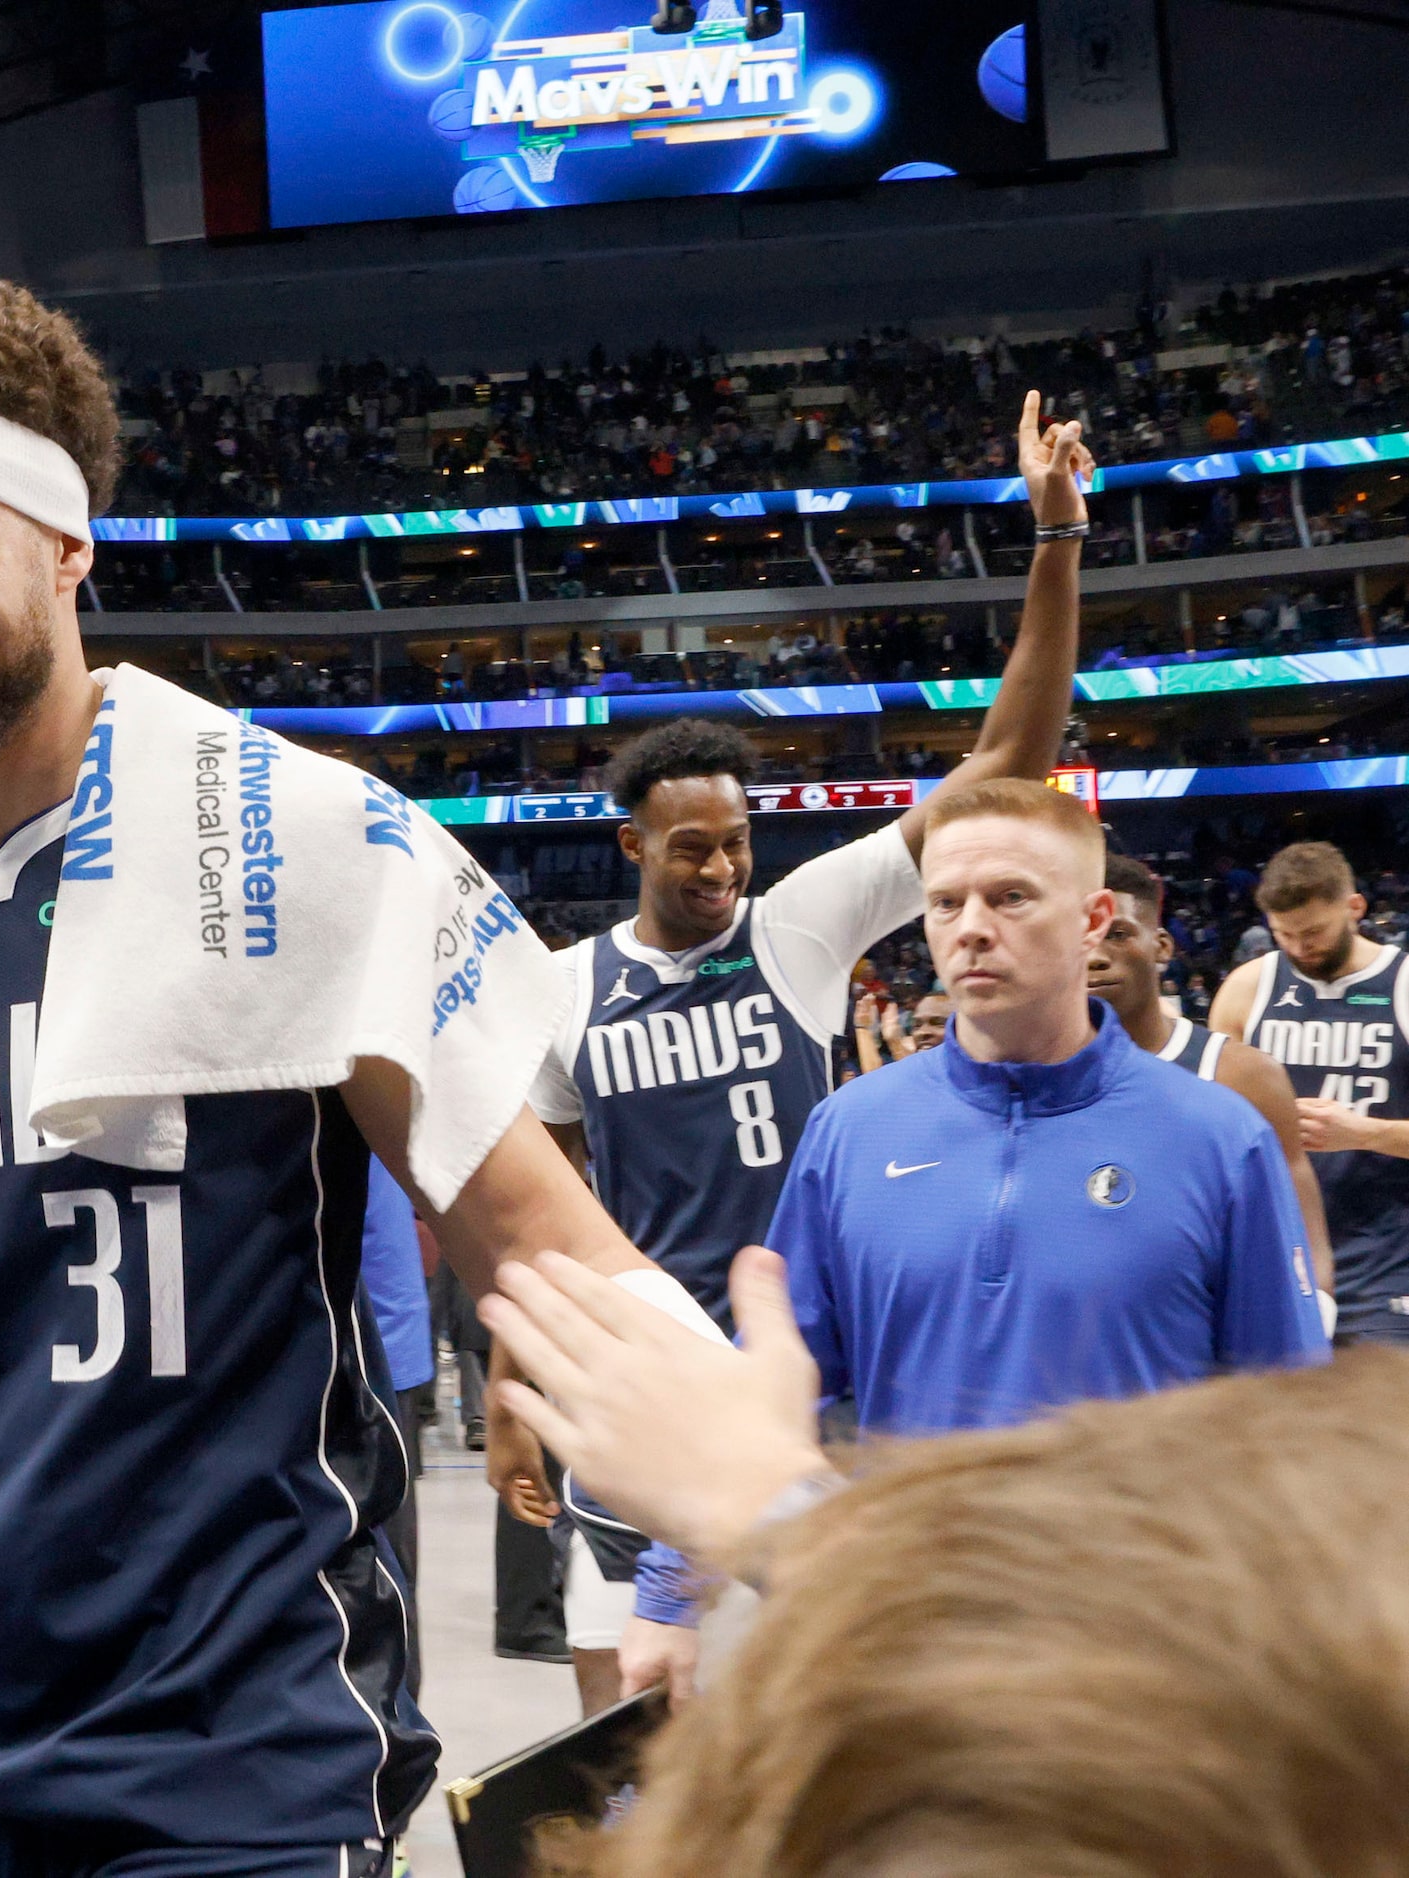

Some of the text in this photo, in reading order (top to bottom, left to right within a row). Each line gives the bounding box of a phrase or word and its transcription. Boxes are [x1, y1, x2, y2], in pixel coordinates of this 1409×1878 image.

[472, 44, 794, 126] Mavs Win
[62, 700, 115, 881] TSW
[535, 807, 547, 818] 2
[574, 805, 587, 817] 5
[843, 795, 855, 807] 3
[883, 793, 896, 805] 2
[196, 731, 232, 959] Medical Center
[587, 993, 783, 1098] MAVS
[1259, 1019, 1394, 1069] MAVS
[728, 1080, 783, 1168] 8
[1318, 1073, 1390, 1117] 42
[42, 1185, 187, 1383] 31
